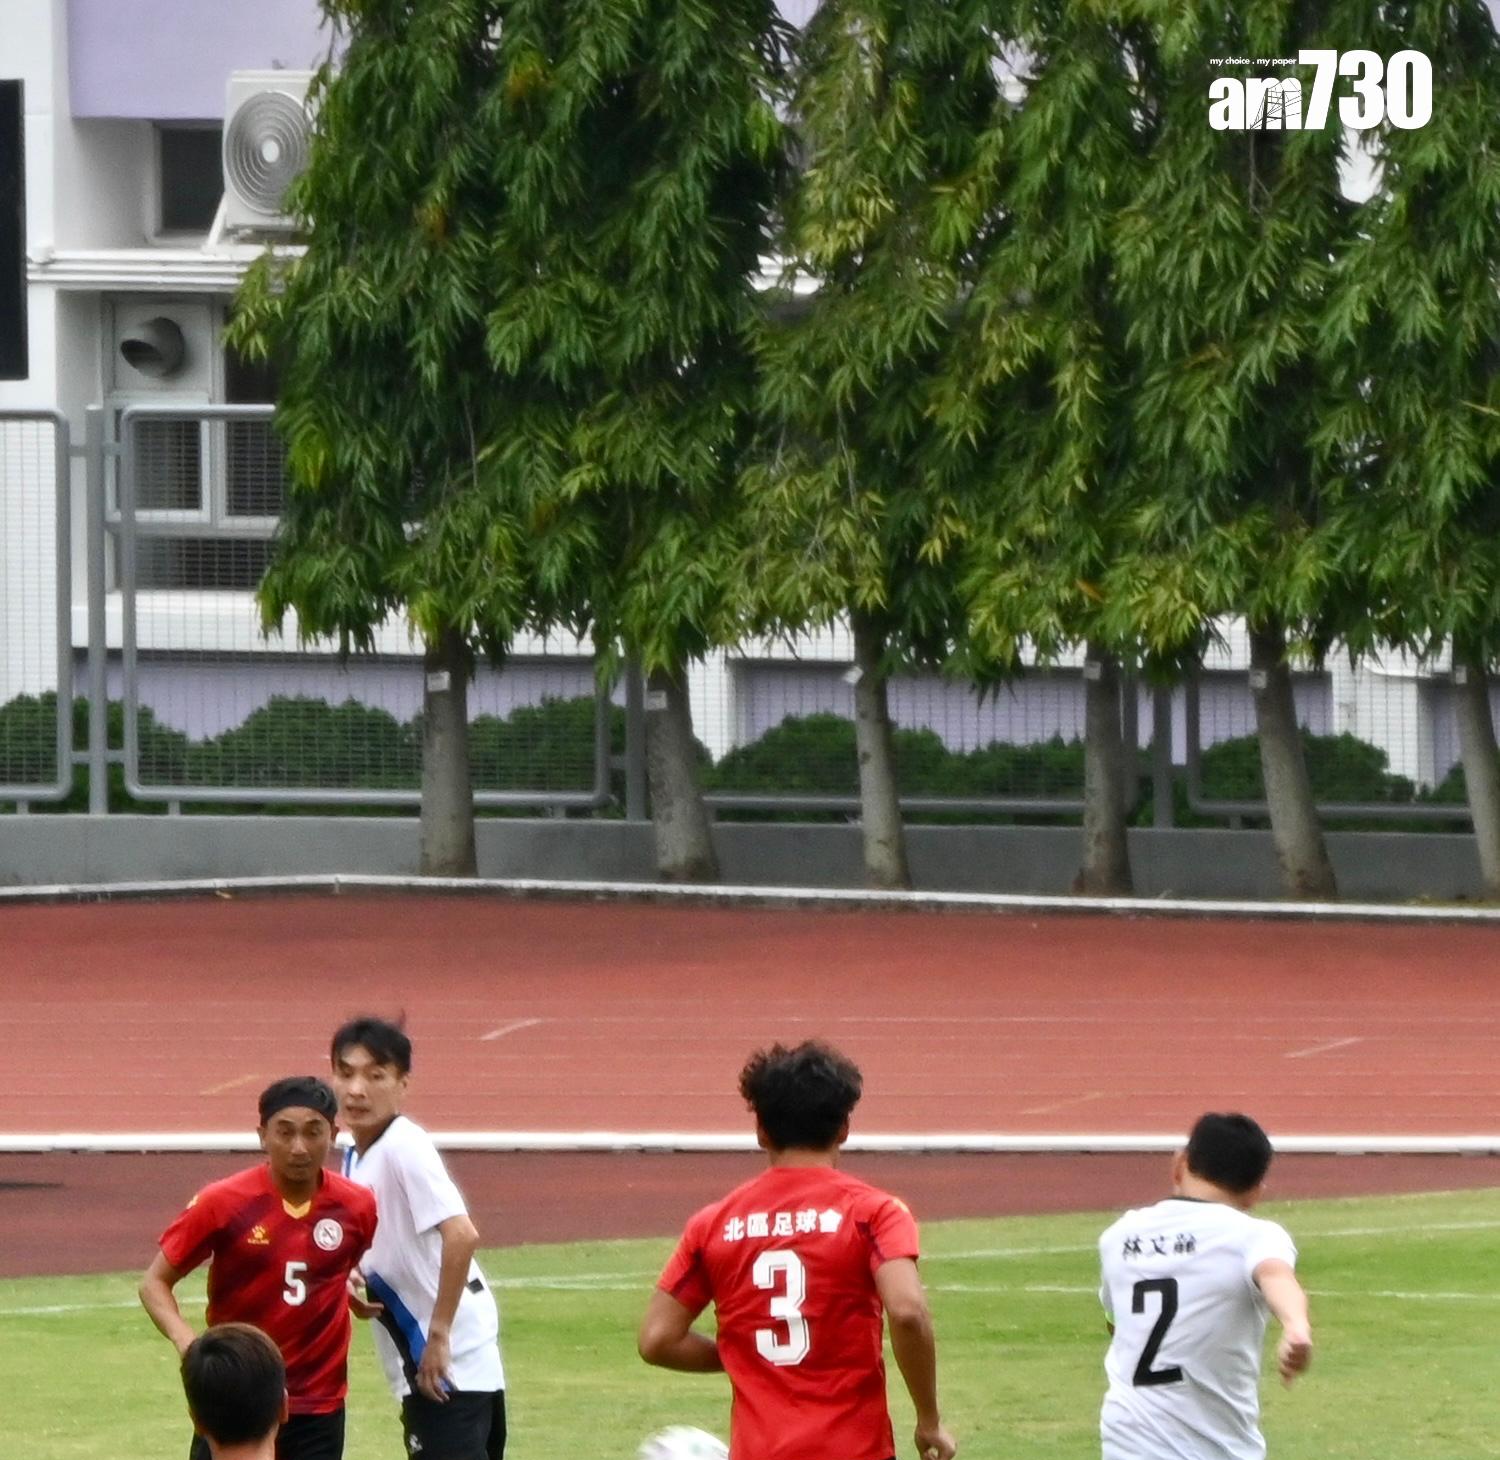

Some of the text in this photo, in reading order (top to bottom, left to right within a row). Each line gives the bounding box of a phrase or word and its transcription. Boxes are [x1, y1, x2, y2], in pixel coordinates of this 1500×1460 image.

[723, 1208, 843, 1242] 北區足球會
[282, 1261, 308, 1306] 5
[752, 1249, 811, 1367] 3
[1131, 1277, 1184, 1387] 2
